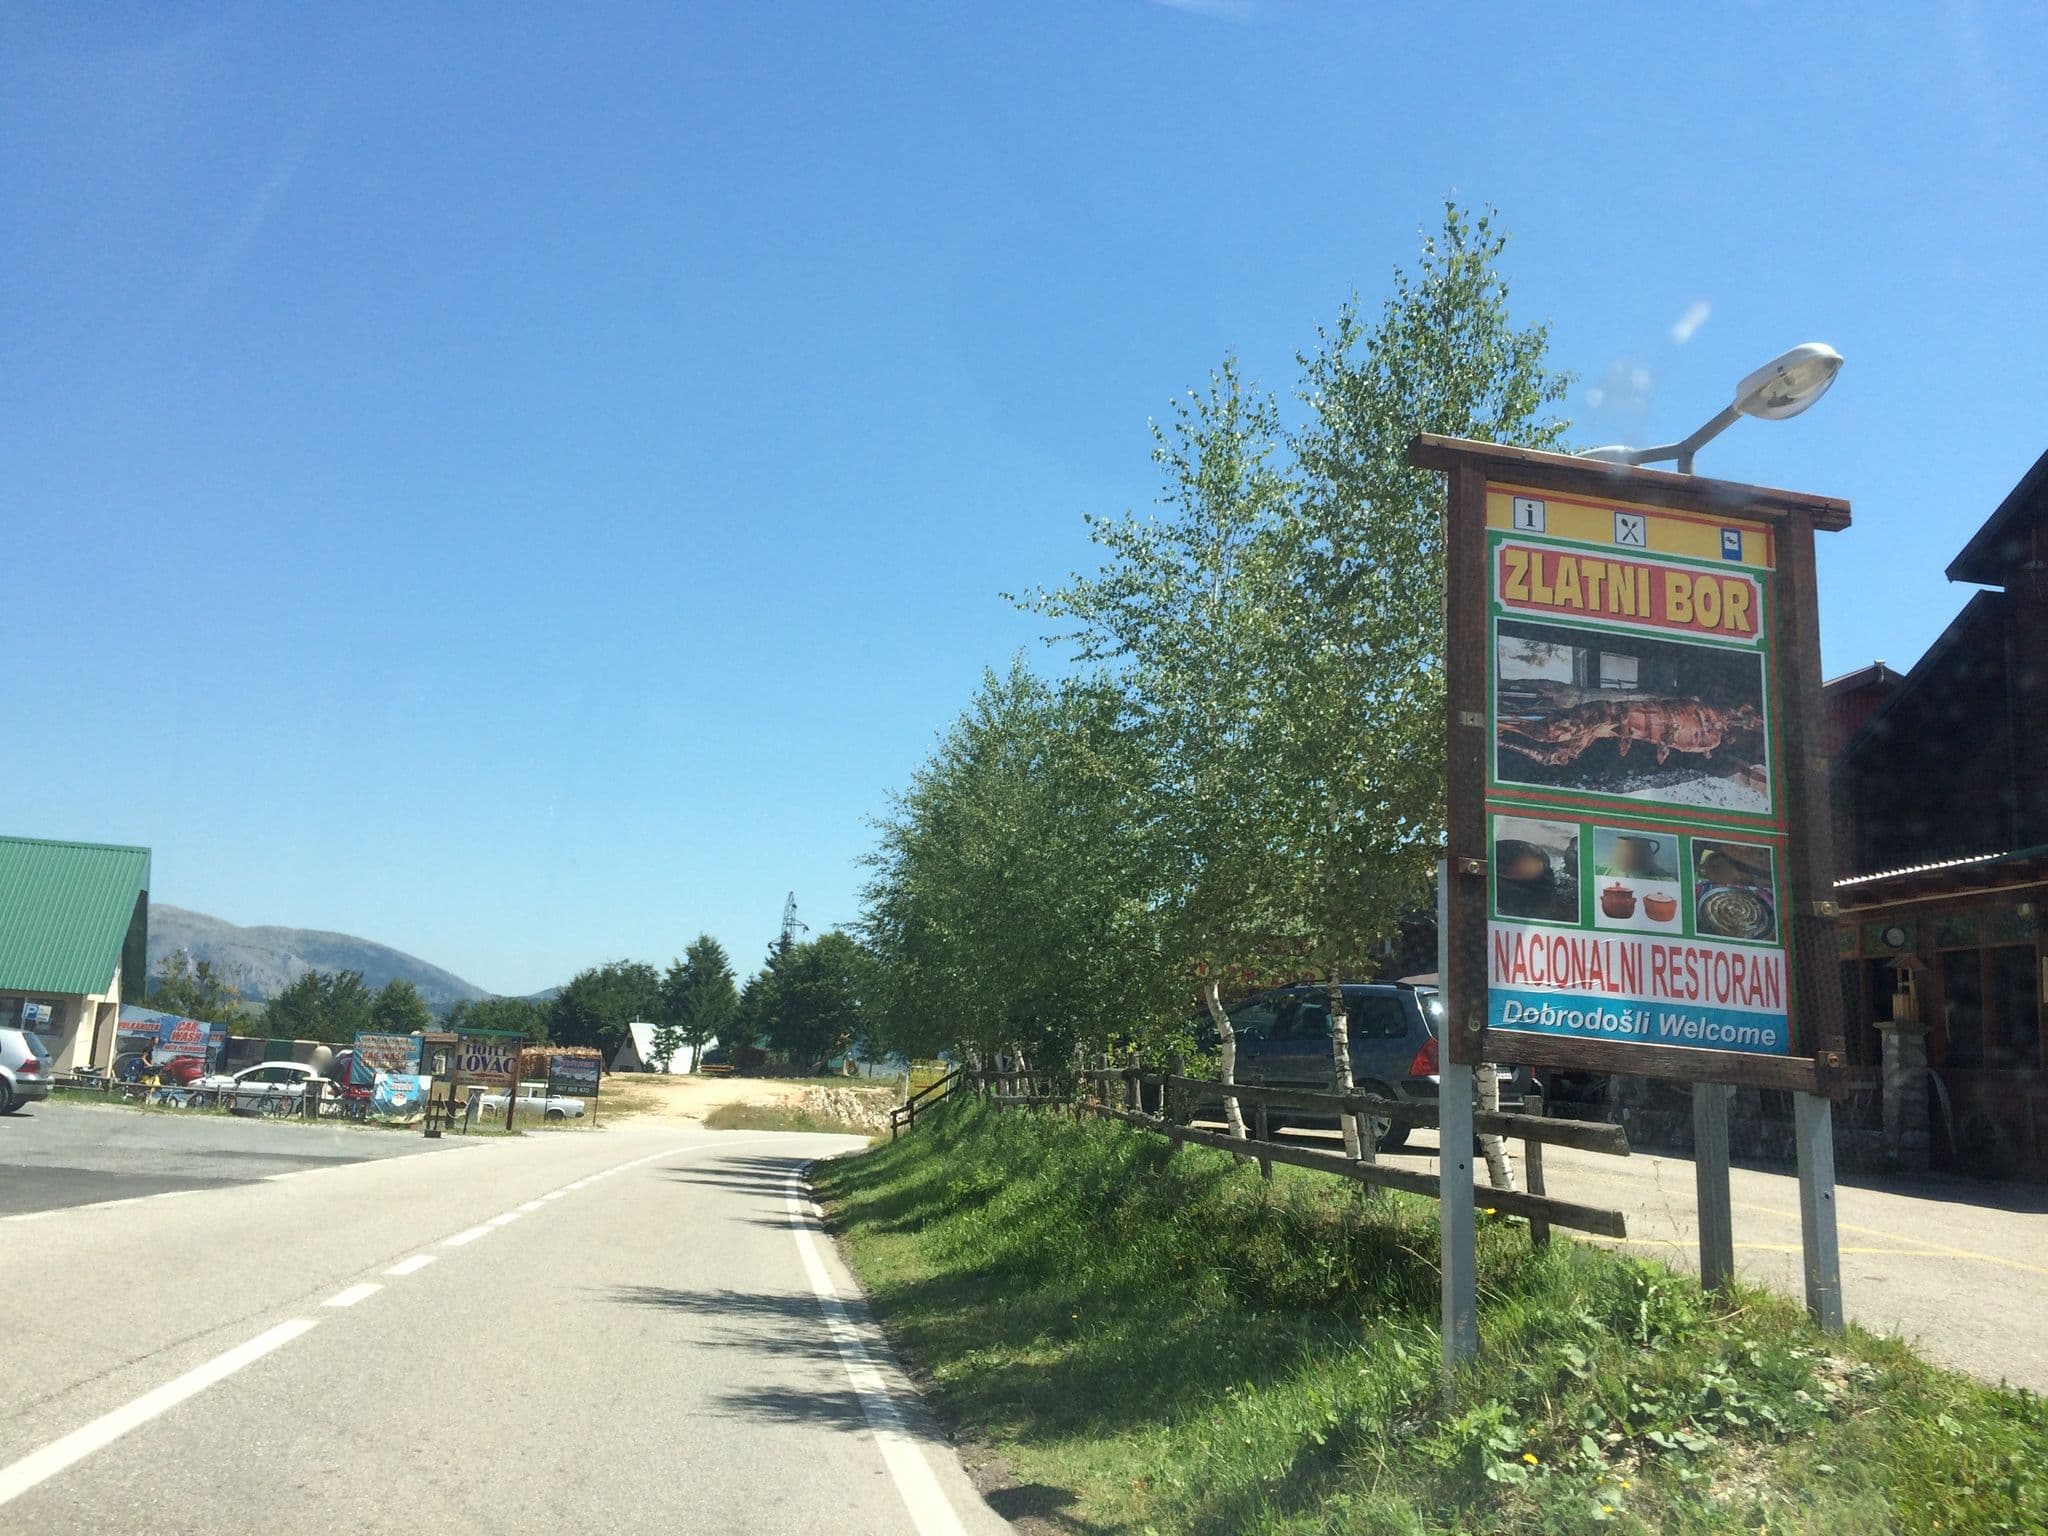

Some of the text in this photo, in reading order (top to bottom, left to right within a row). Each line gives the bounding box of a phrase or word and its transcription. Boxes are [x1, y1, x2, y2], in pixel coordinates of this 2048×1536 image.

[1504, 549, 1751, 632] ZLATNI BOR
[1495, 929, 1781, 1009] NACIONALNI RESTORAN
[176, 1021, 198, 1032] CAR
[1502, 999, 1777, 1047] Dobrodošli Welcome
[171, 1032, 201, 1042] WASH
[465, 1043, 507, 1057] HOTEL
[455, 1054, 517, 1075] LOVAC
